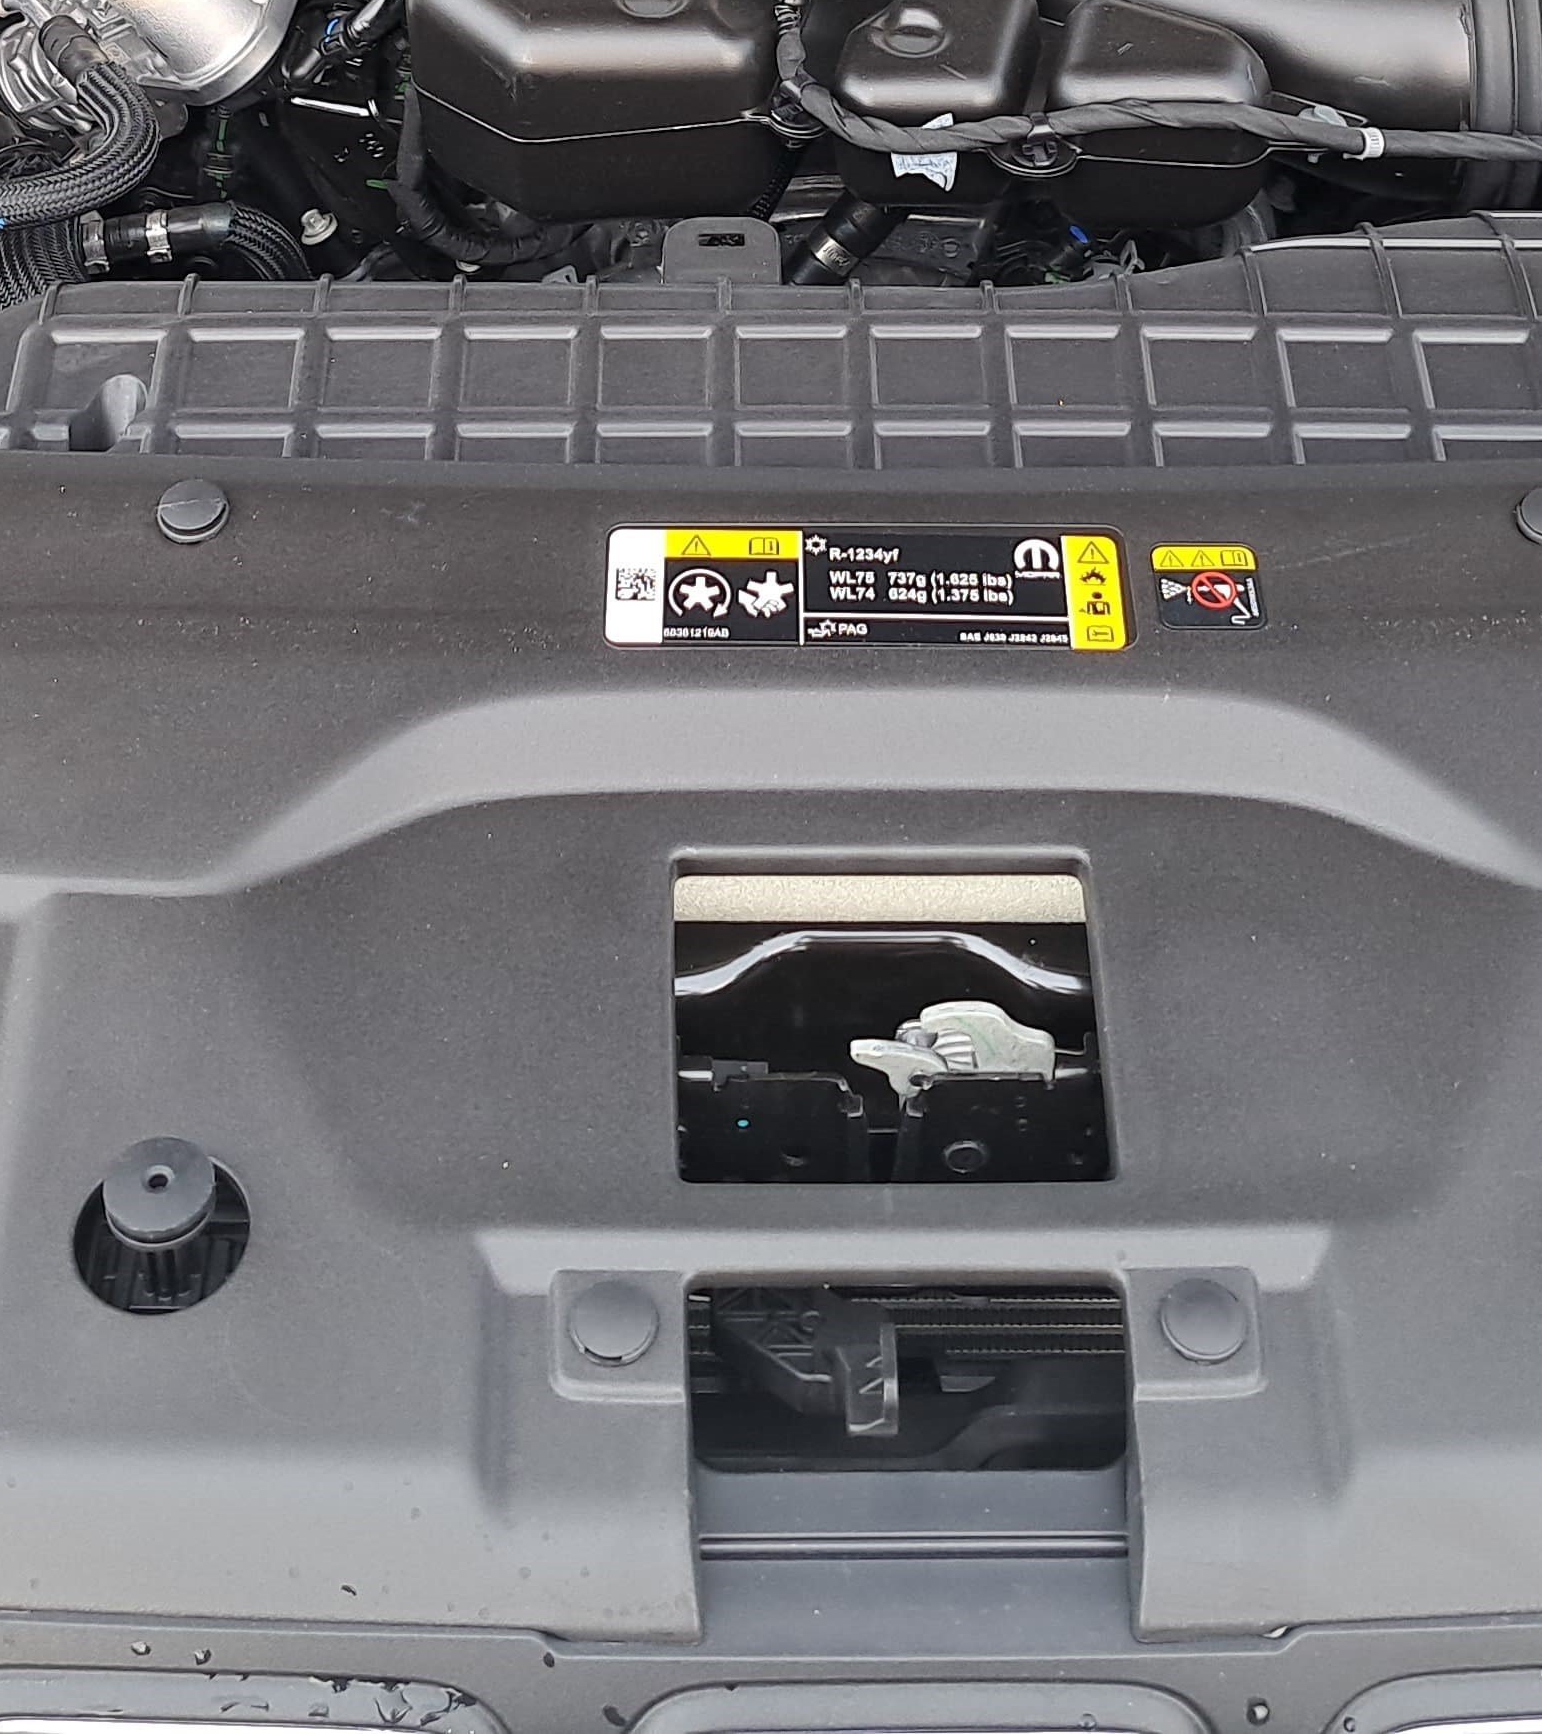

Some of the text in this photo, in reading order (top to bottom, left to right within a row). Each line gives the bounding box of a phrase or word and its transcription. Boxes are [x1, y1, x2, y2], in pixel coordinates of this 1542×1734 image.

[829, 547, 900, 565] R-1234yf
[887, 571, 927, 588] 737g
[982, 572, 1012, 589] lbs)
[829, 586, 1014, 606] WL74 624g (1.375 lbs)
[837, 624, 868, 636] PAG
